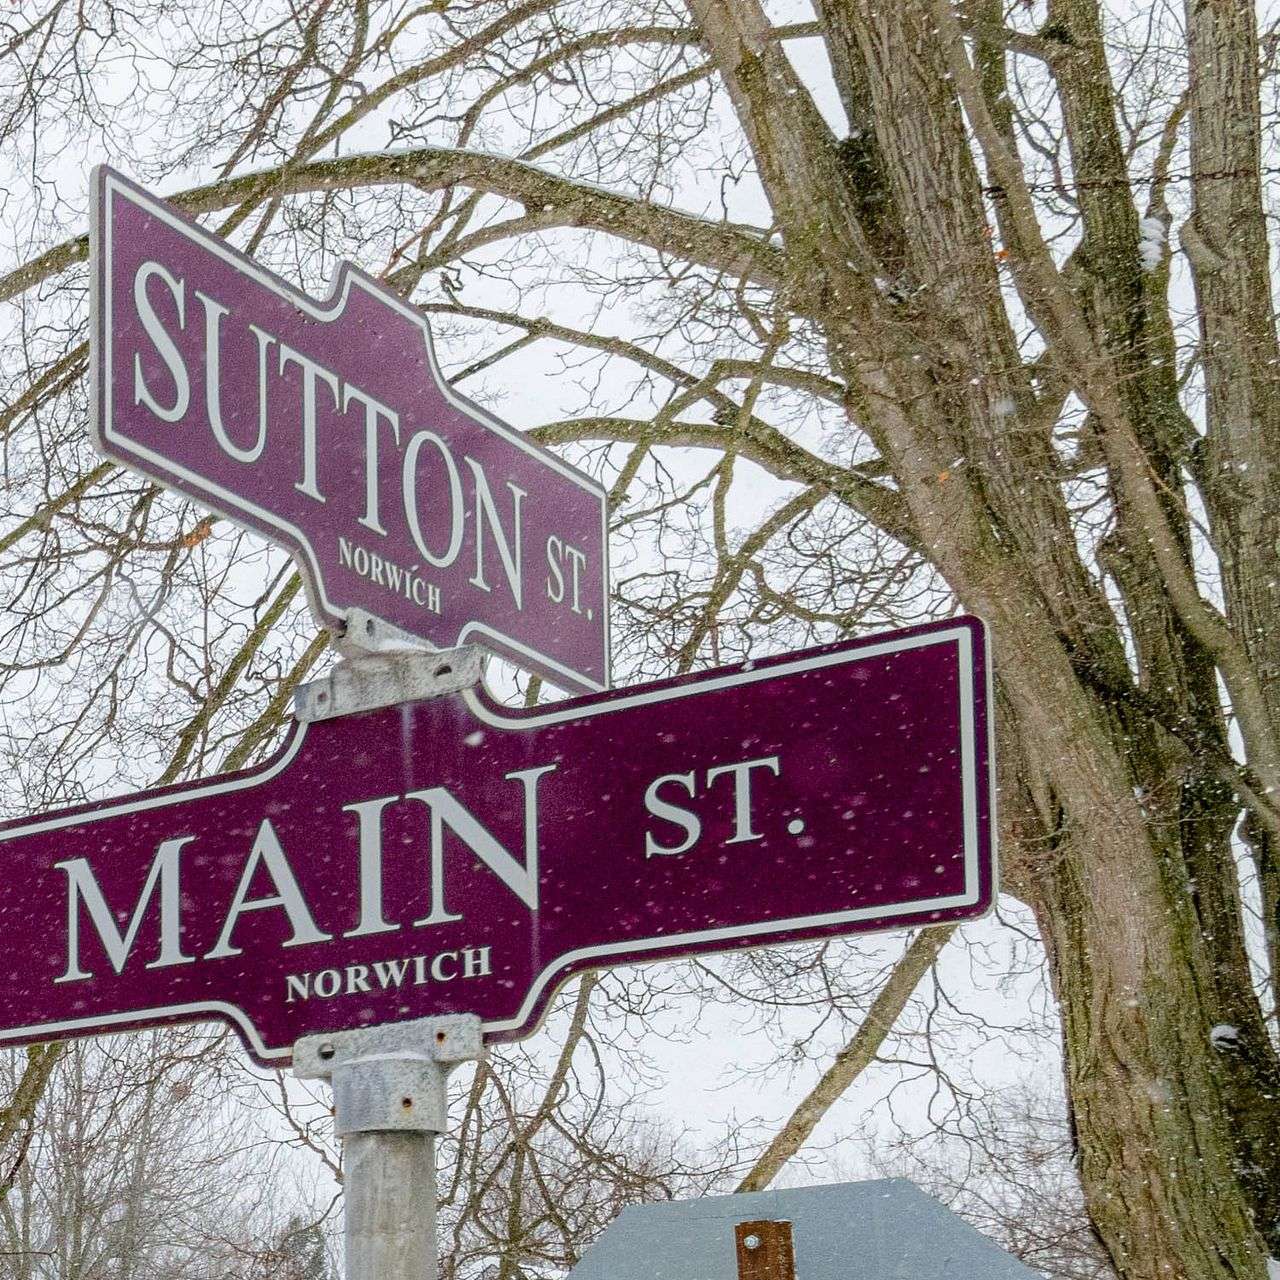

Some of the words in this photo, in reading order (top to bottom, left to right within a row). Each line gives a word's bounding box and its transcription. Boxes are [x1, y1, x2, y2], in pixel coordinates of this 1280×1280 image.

[133, 260, 528, 612] SUTTON
[545, 534, 595, 620] ST.
[337, 536, 443, 616] NORWICH
[52, 763, 558, 985] MAIN
[642, 755, 807, 861] ST.
[284, 945, 493, 1004] NORWICH
